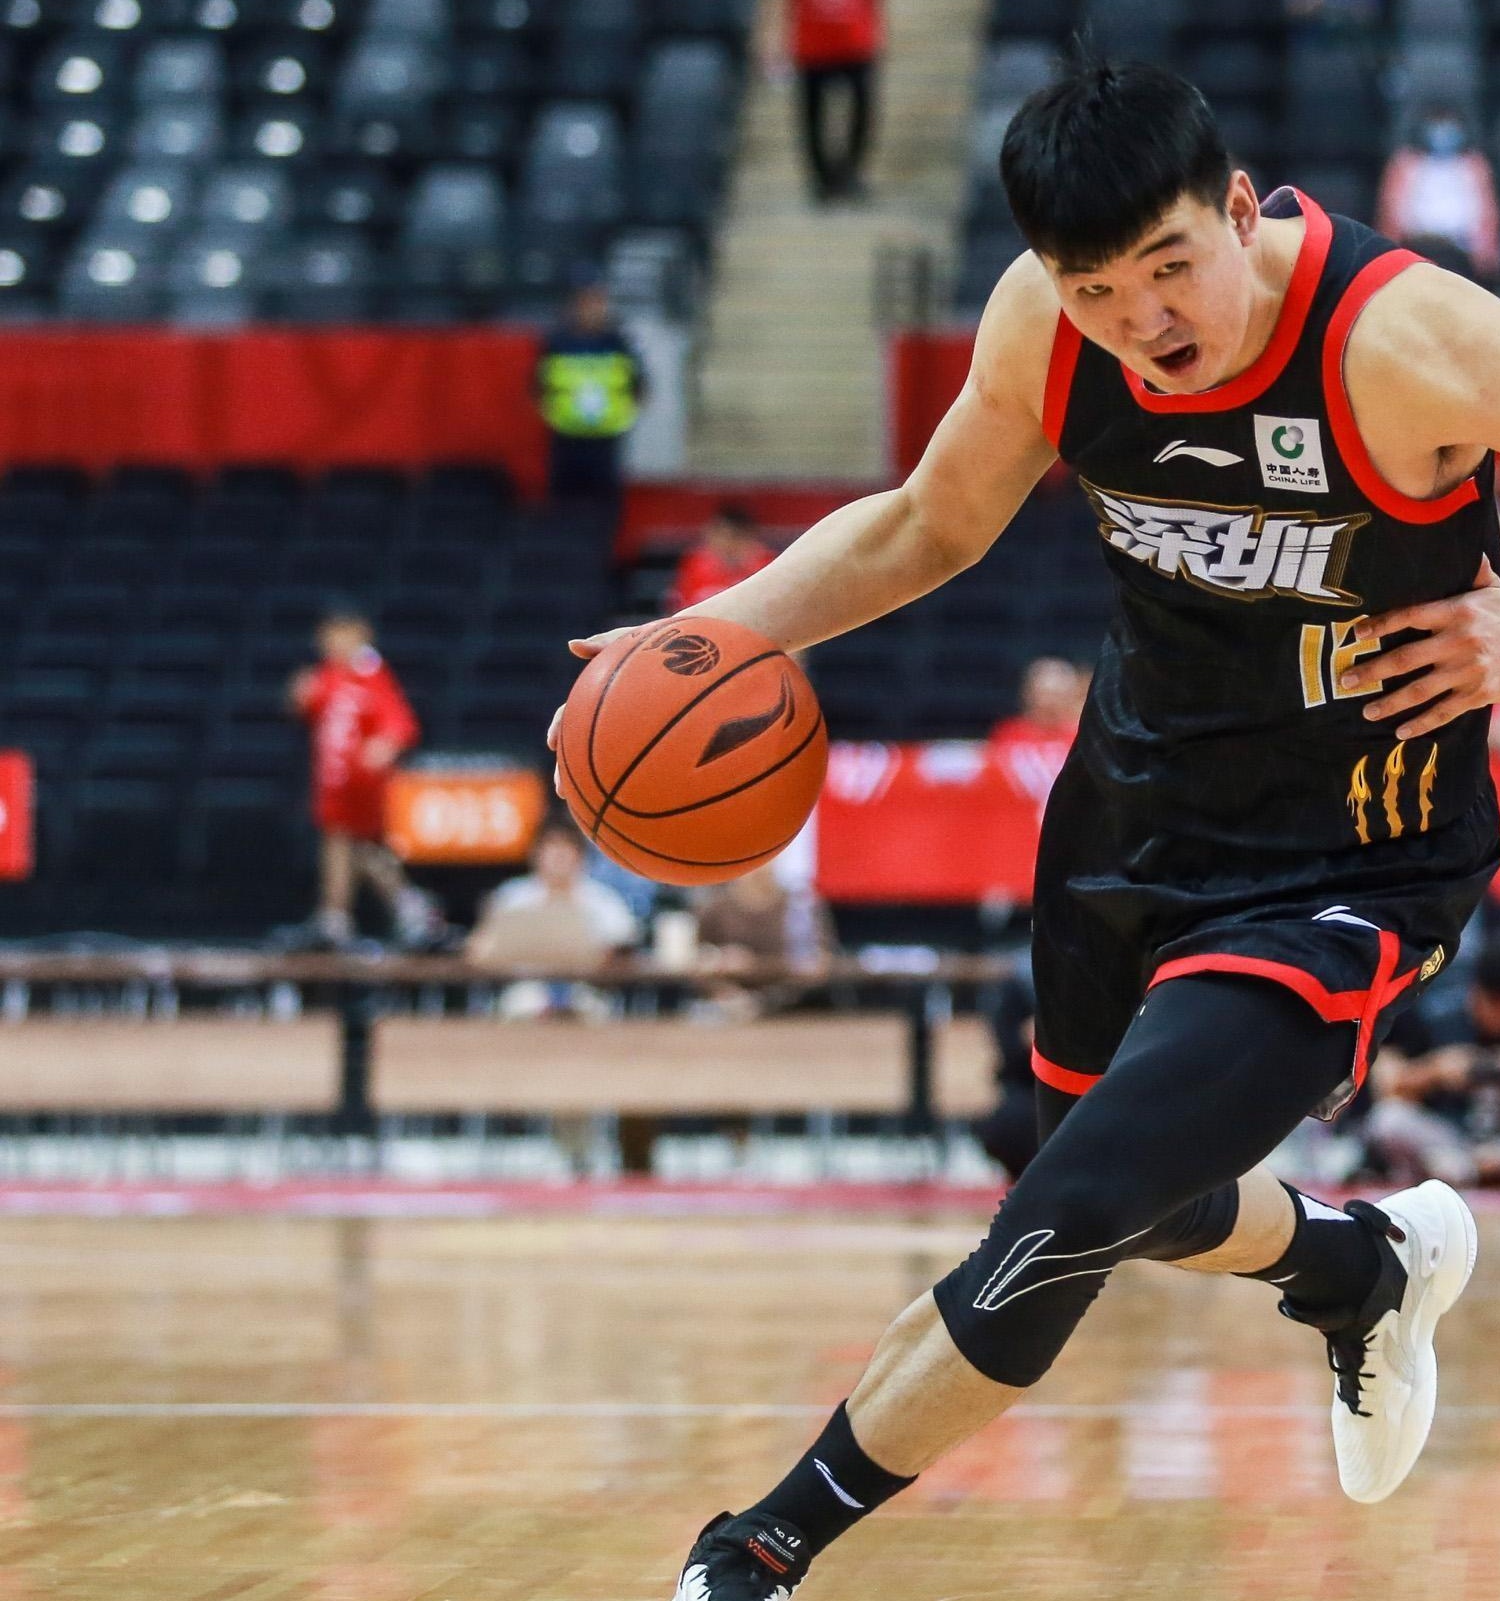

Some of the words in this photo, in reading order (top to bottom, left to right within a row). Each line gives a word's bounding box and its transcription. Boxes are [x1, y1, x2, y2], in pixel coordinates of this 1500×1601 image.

[1268, 475, 1297, 484] CHINA
[1088, 486, 1358, 602] 深圳
[1299, 614, 1383, 709] 12
